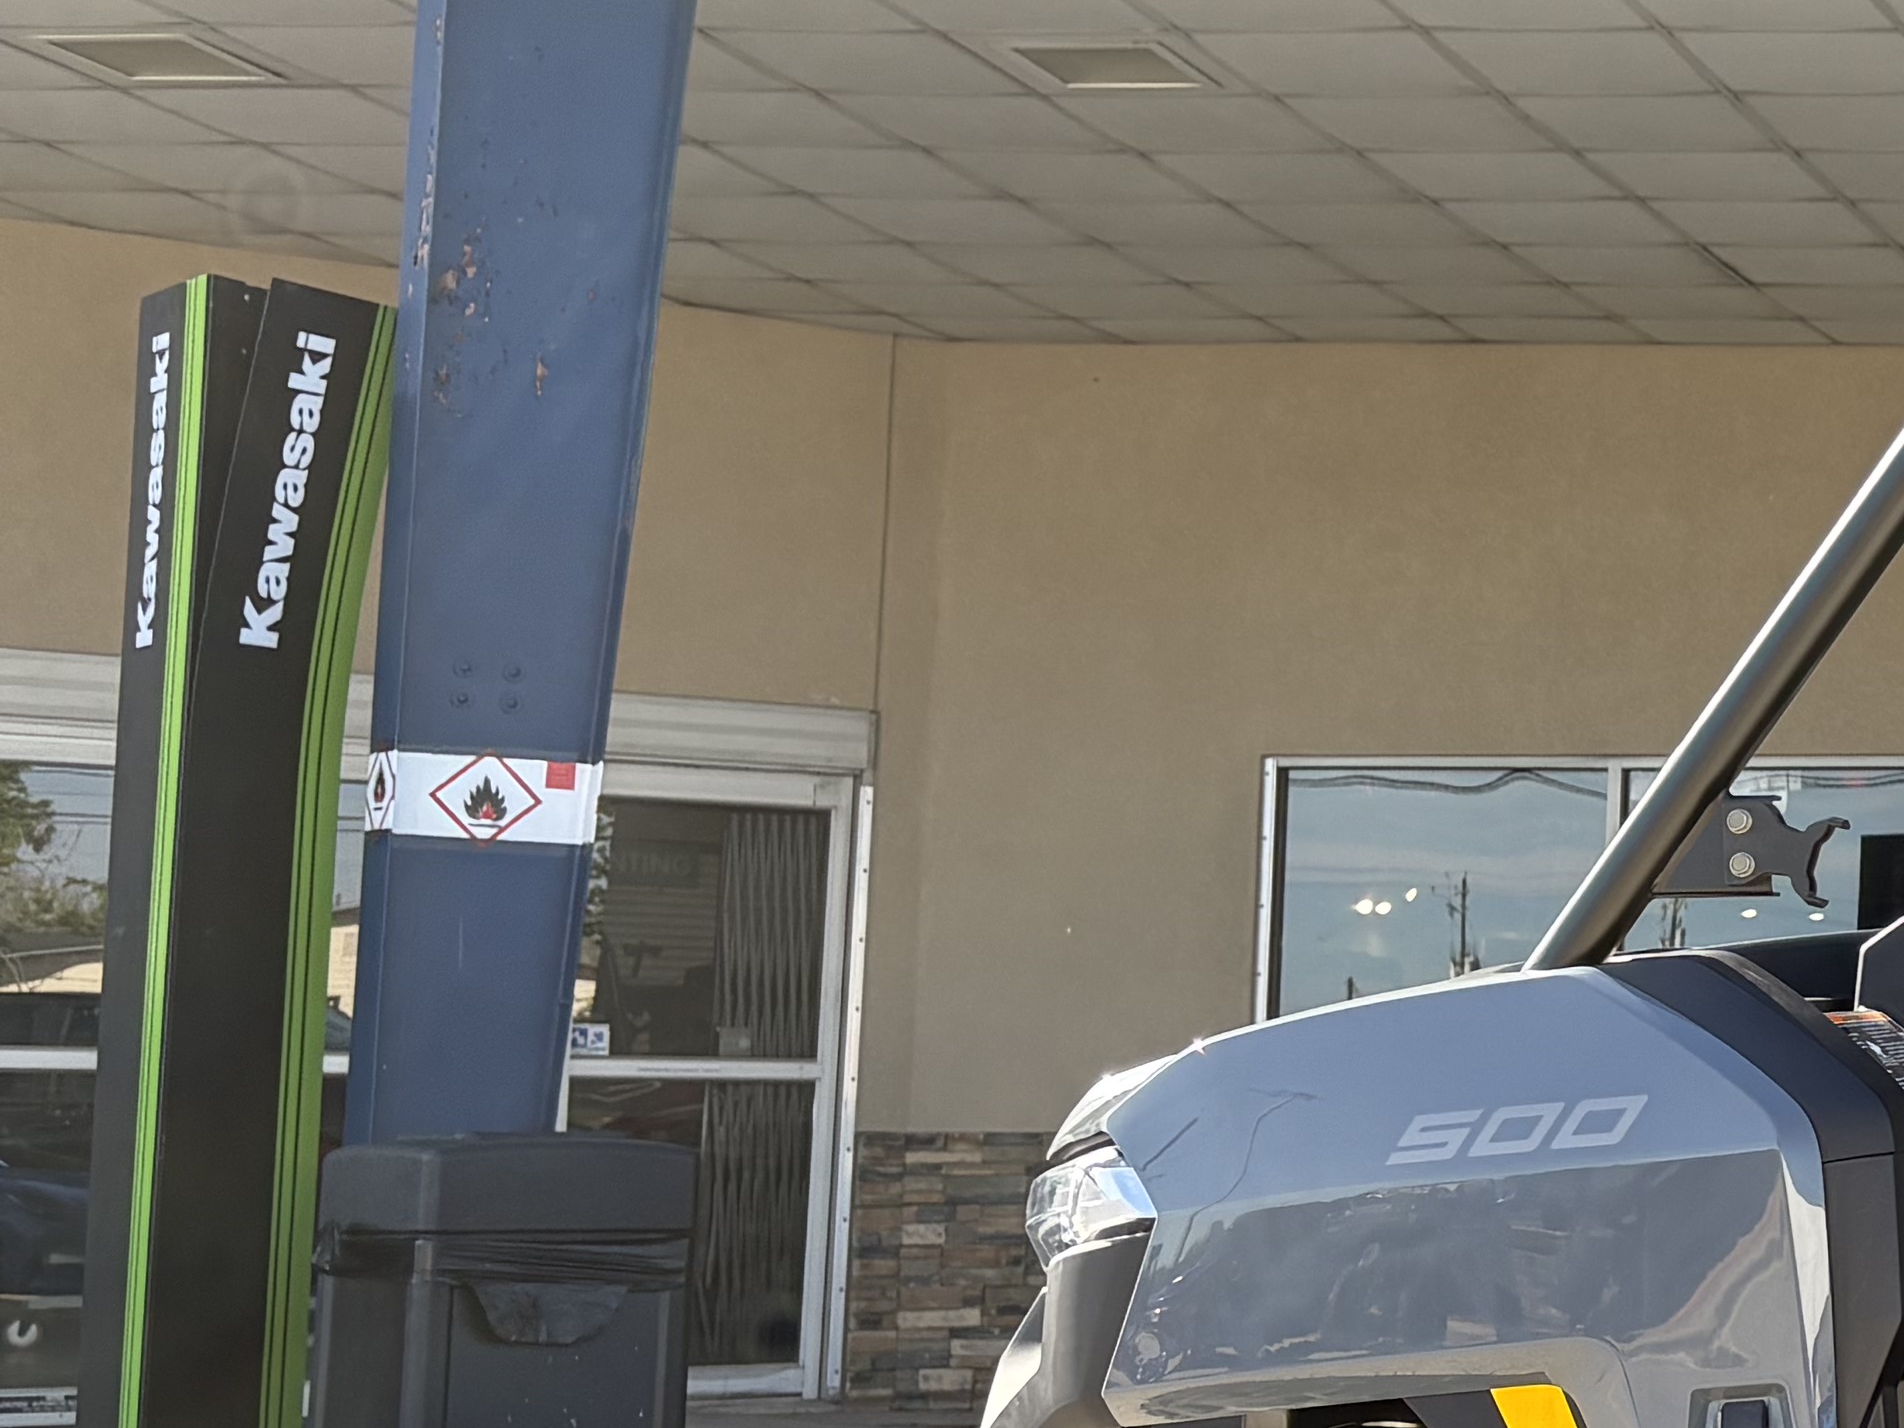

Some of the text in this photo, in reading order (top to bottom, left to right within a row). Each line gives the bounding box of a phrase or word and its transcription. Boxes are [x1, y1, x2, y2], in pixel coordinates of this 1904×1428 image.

[135, 331, 171, 649] Kawasaki
[239, 331, 337, 649] Kawasaki
[1384, 1094, 1650, 1166] 500
